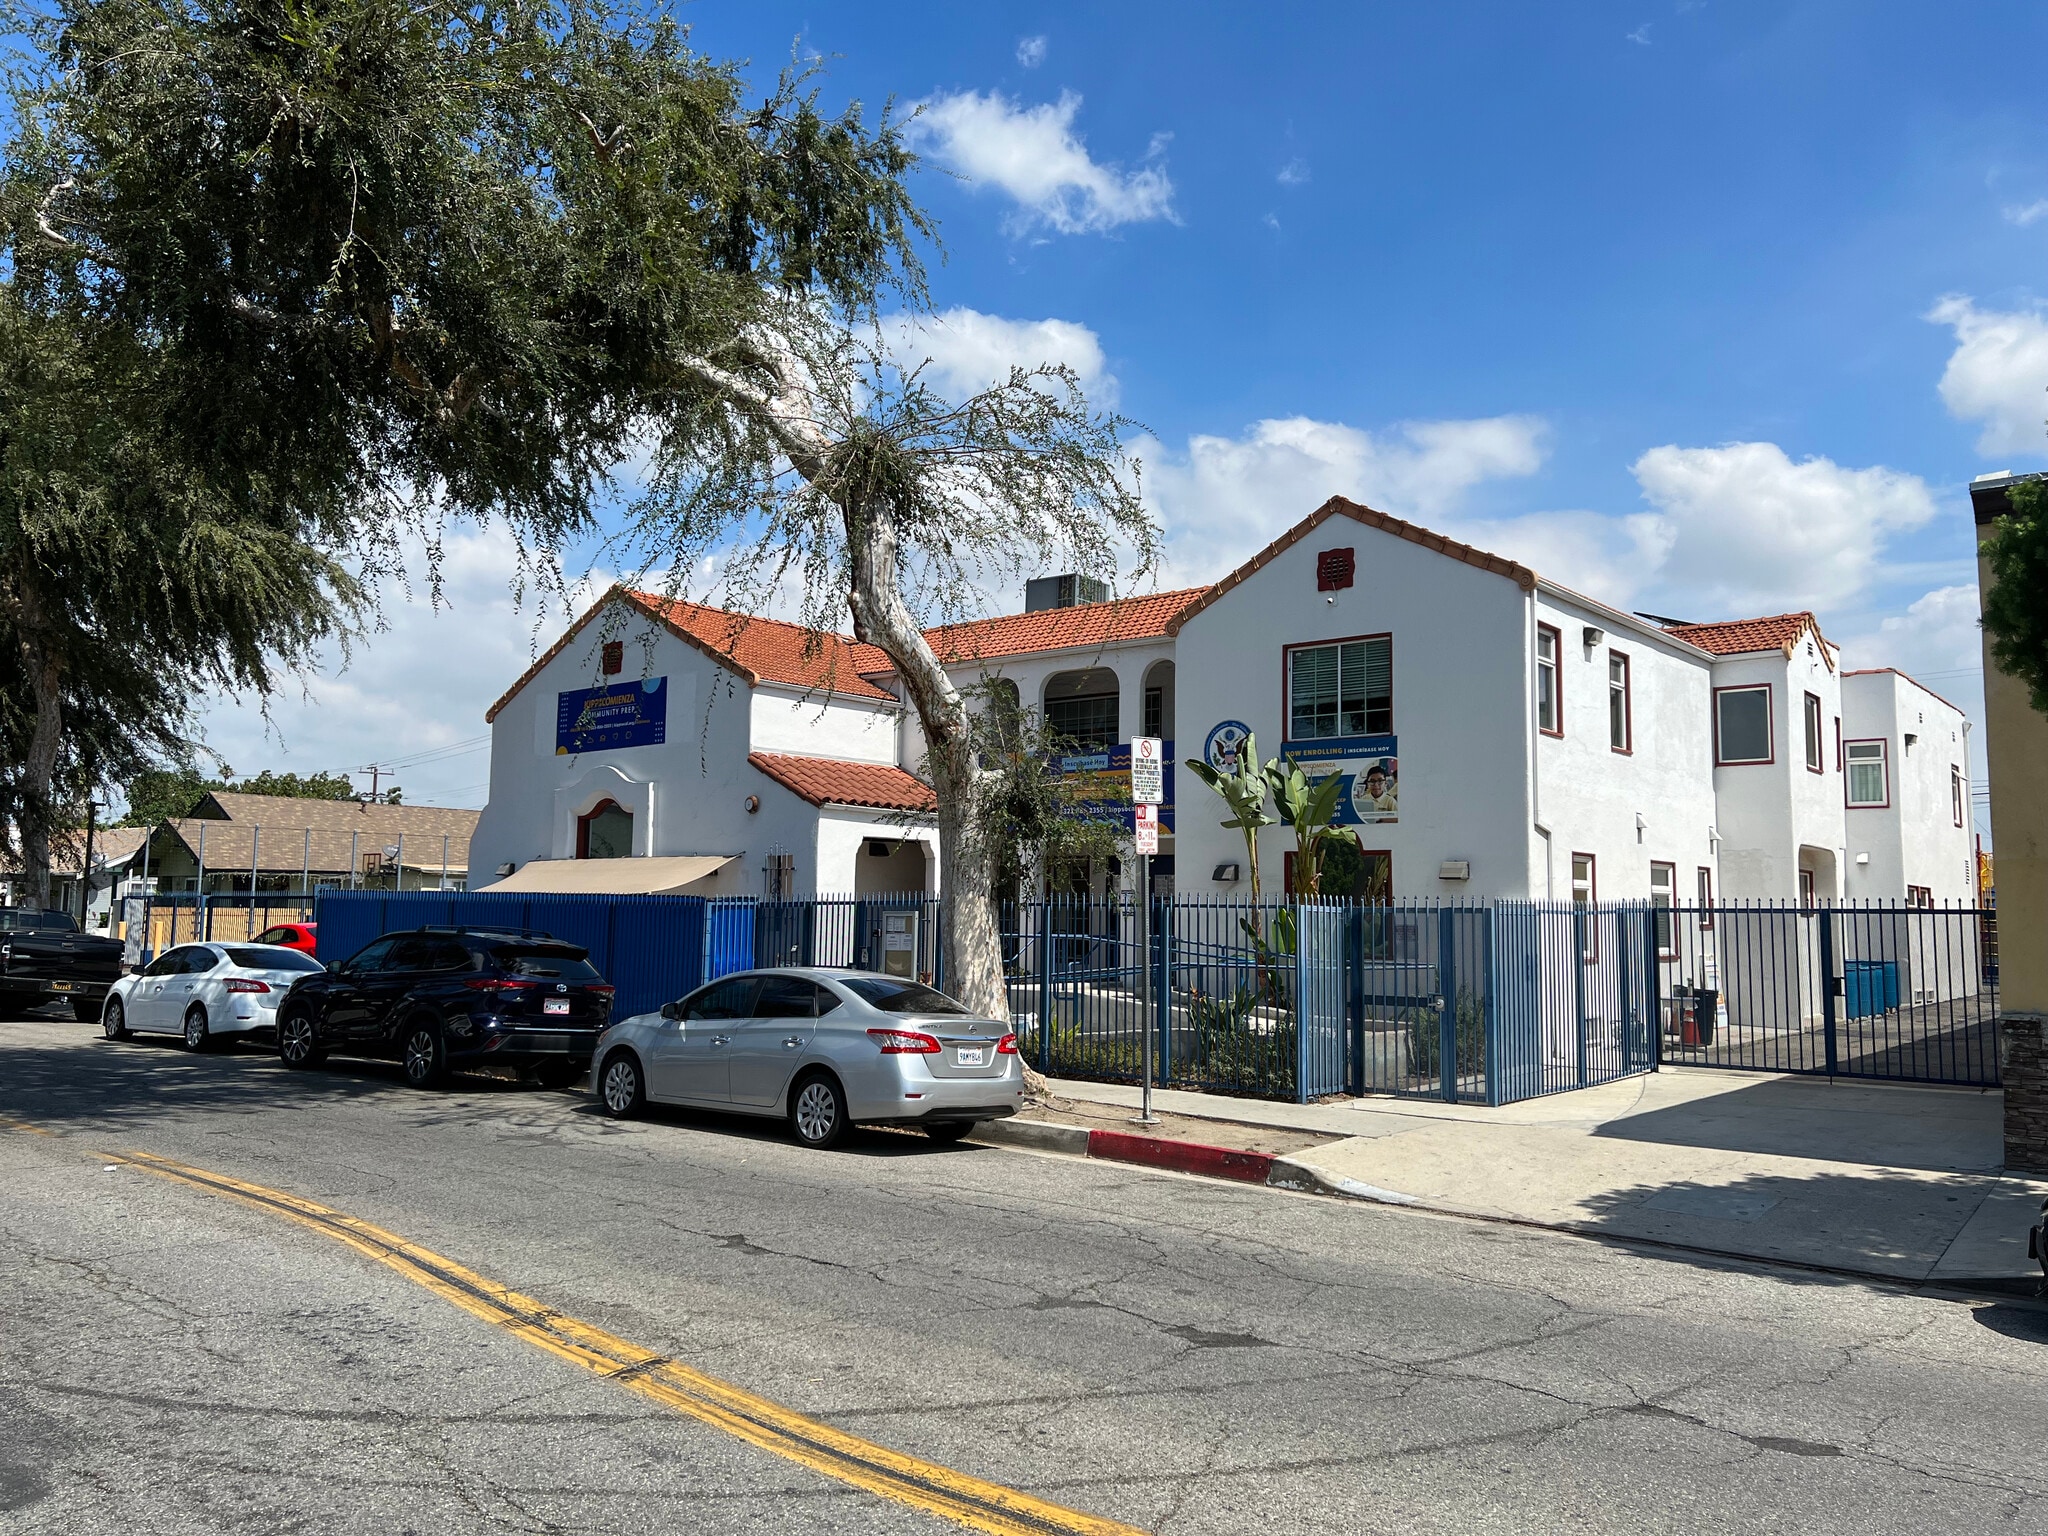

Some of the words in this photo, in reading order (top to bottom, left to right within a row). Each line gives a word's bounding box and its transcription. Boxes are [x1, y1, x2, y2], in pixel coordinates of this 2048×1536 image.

[1303, 748, 1342, 756] ENROLLING
[1137, 806, 1145, 818] NO
[1138, 820, 1156, 830] PARKING
